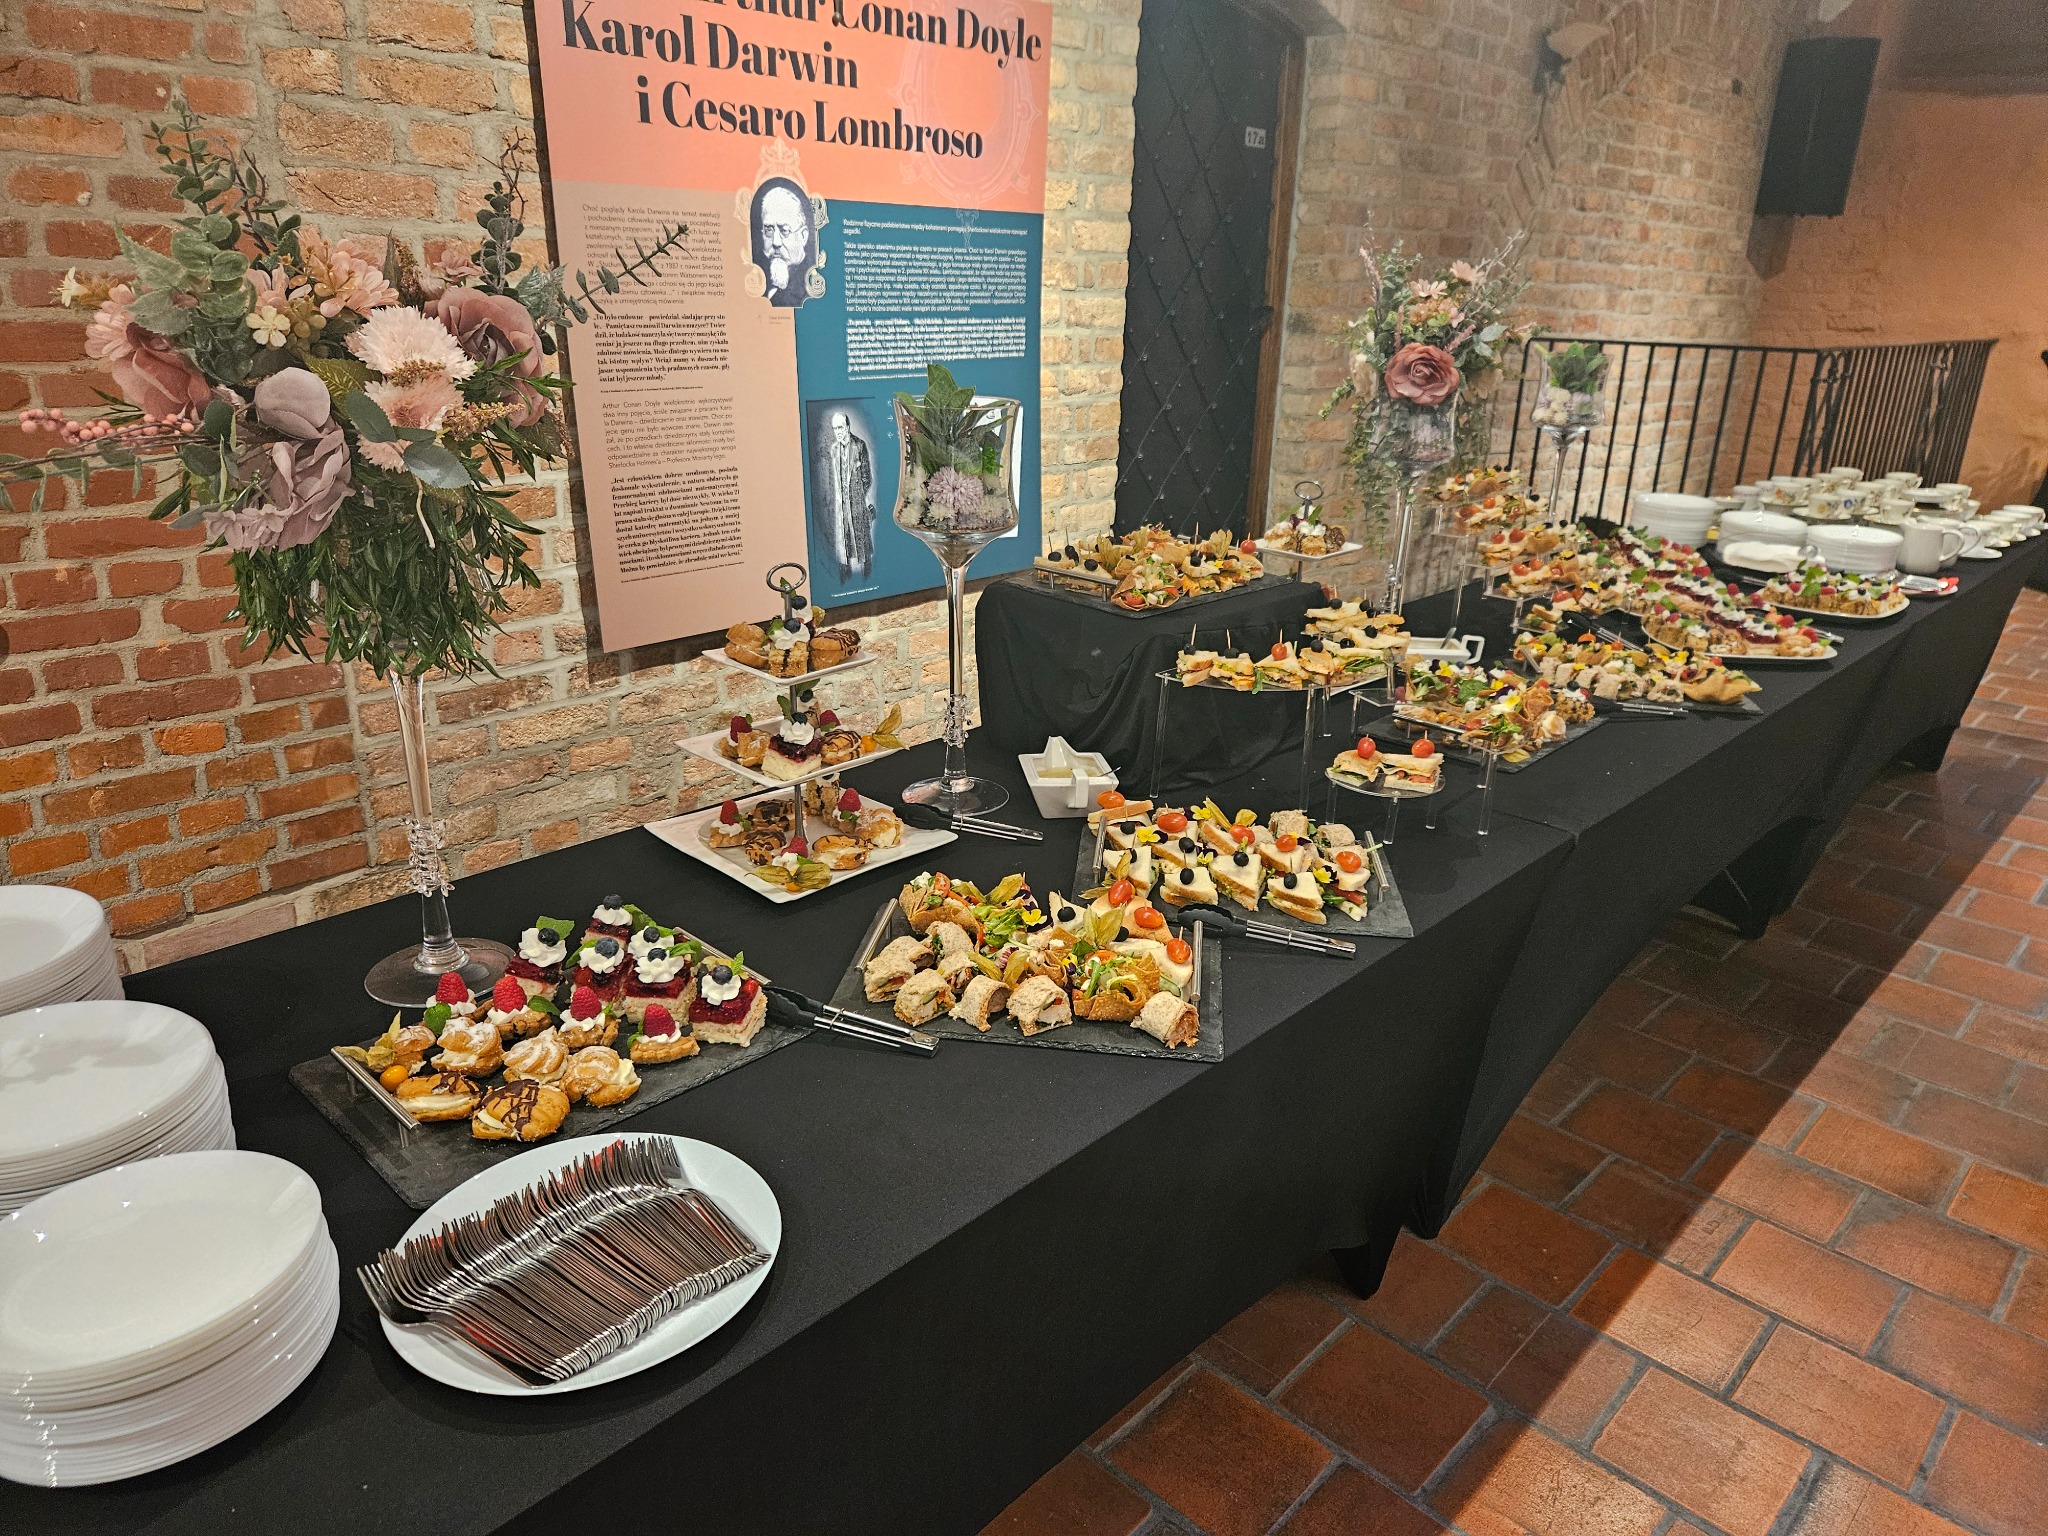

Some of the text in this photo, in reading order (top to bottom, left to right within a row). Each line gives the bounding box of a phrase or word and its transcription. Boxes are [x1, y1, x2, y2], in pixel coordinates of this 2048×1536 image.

[563, 0, 858, 89] Karol Darwin
[838, 0, 949, 46] Conan
[956, 7, 1042, 69] Doyle
[635, 75, 983, 158] i Cesaro Lombroso
